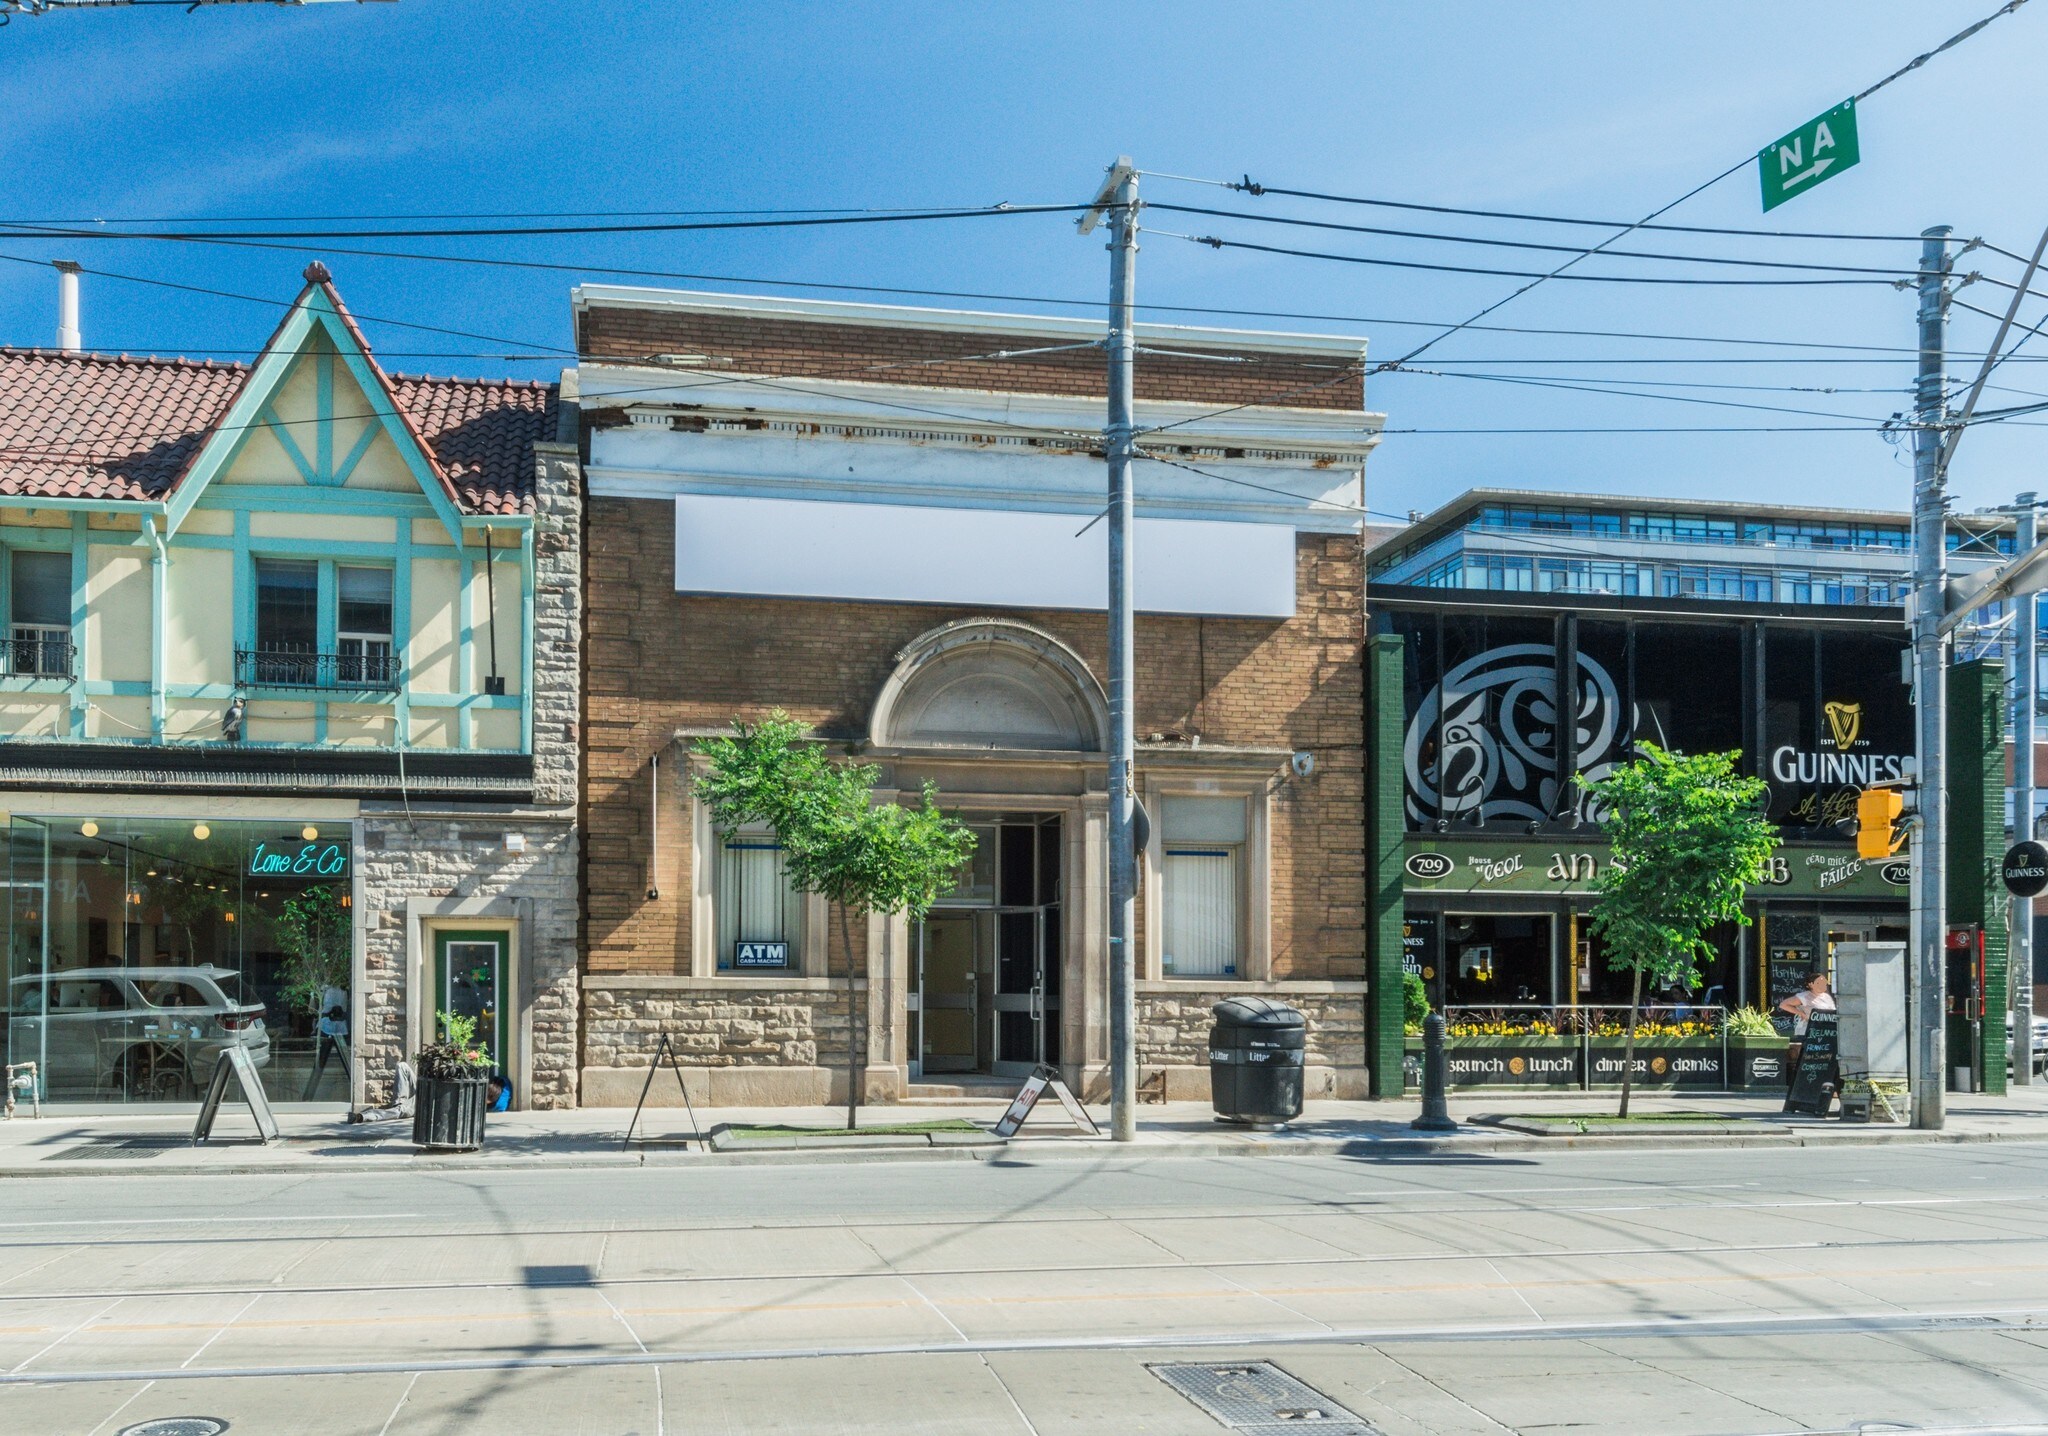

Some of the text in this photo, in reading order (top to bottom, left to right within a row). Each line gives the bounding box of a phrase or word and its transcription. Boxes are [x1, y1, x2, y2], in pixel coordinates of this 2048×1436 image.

[1773, 745, 1916, 784] GUINNES
[317, 845, 347, 874] Co
[1468, 856, 1492, 866] House
[1416, 859, 1443, 873] 709
[2005, 867, 2045, 878] GUINNESS
[740, 945, 784, 959] ATM
[1810, 1011, 1837, 1022] GUINNE
[1214, 1051, 1229, 1061] Litter
[1249, 1051, 1271, 1062] Litter
